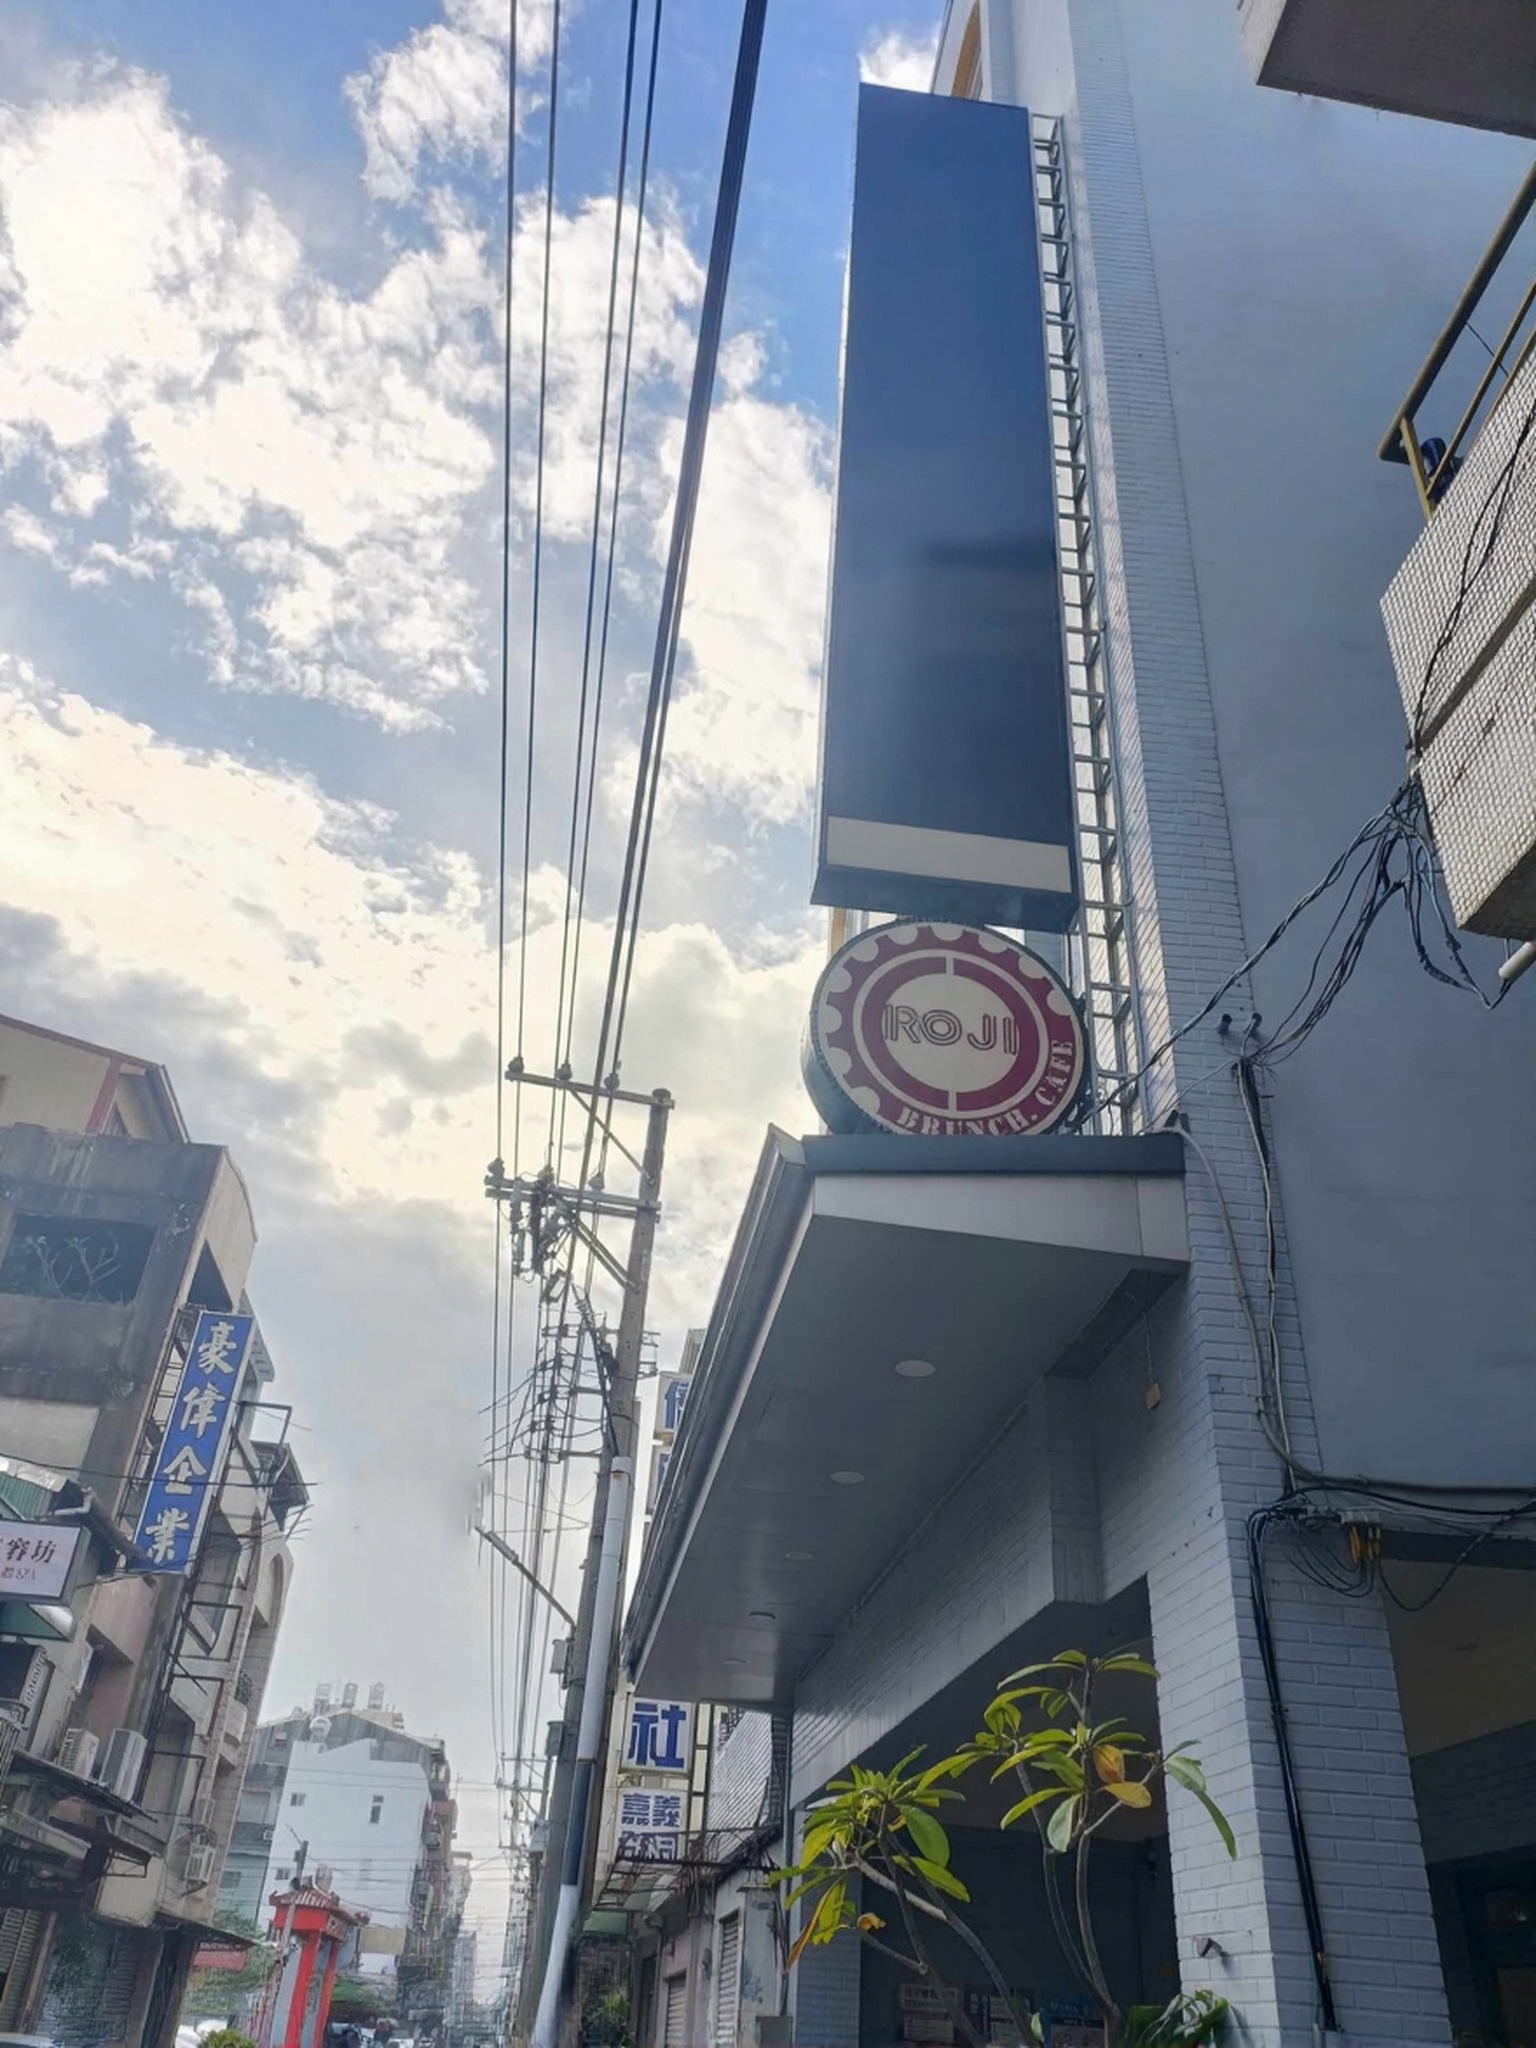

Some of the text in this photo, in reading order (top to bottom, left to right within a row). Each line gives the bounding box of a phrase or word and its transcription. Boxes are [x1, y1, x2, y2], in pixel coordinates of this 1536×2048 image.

[883, 1003, 1018, 1057] ROJI
[145, 1321, 237, 1565] 豪偉企業
[621, 1793, 681, 1828] 嘉義
